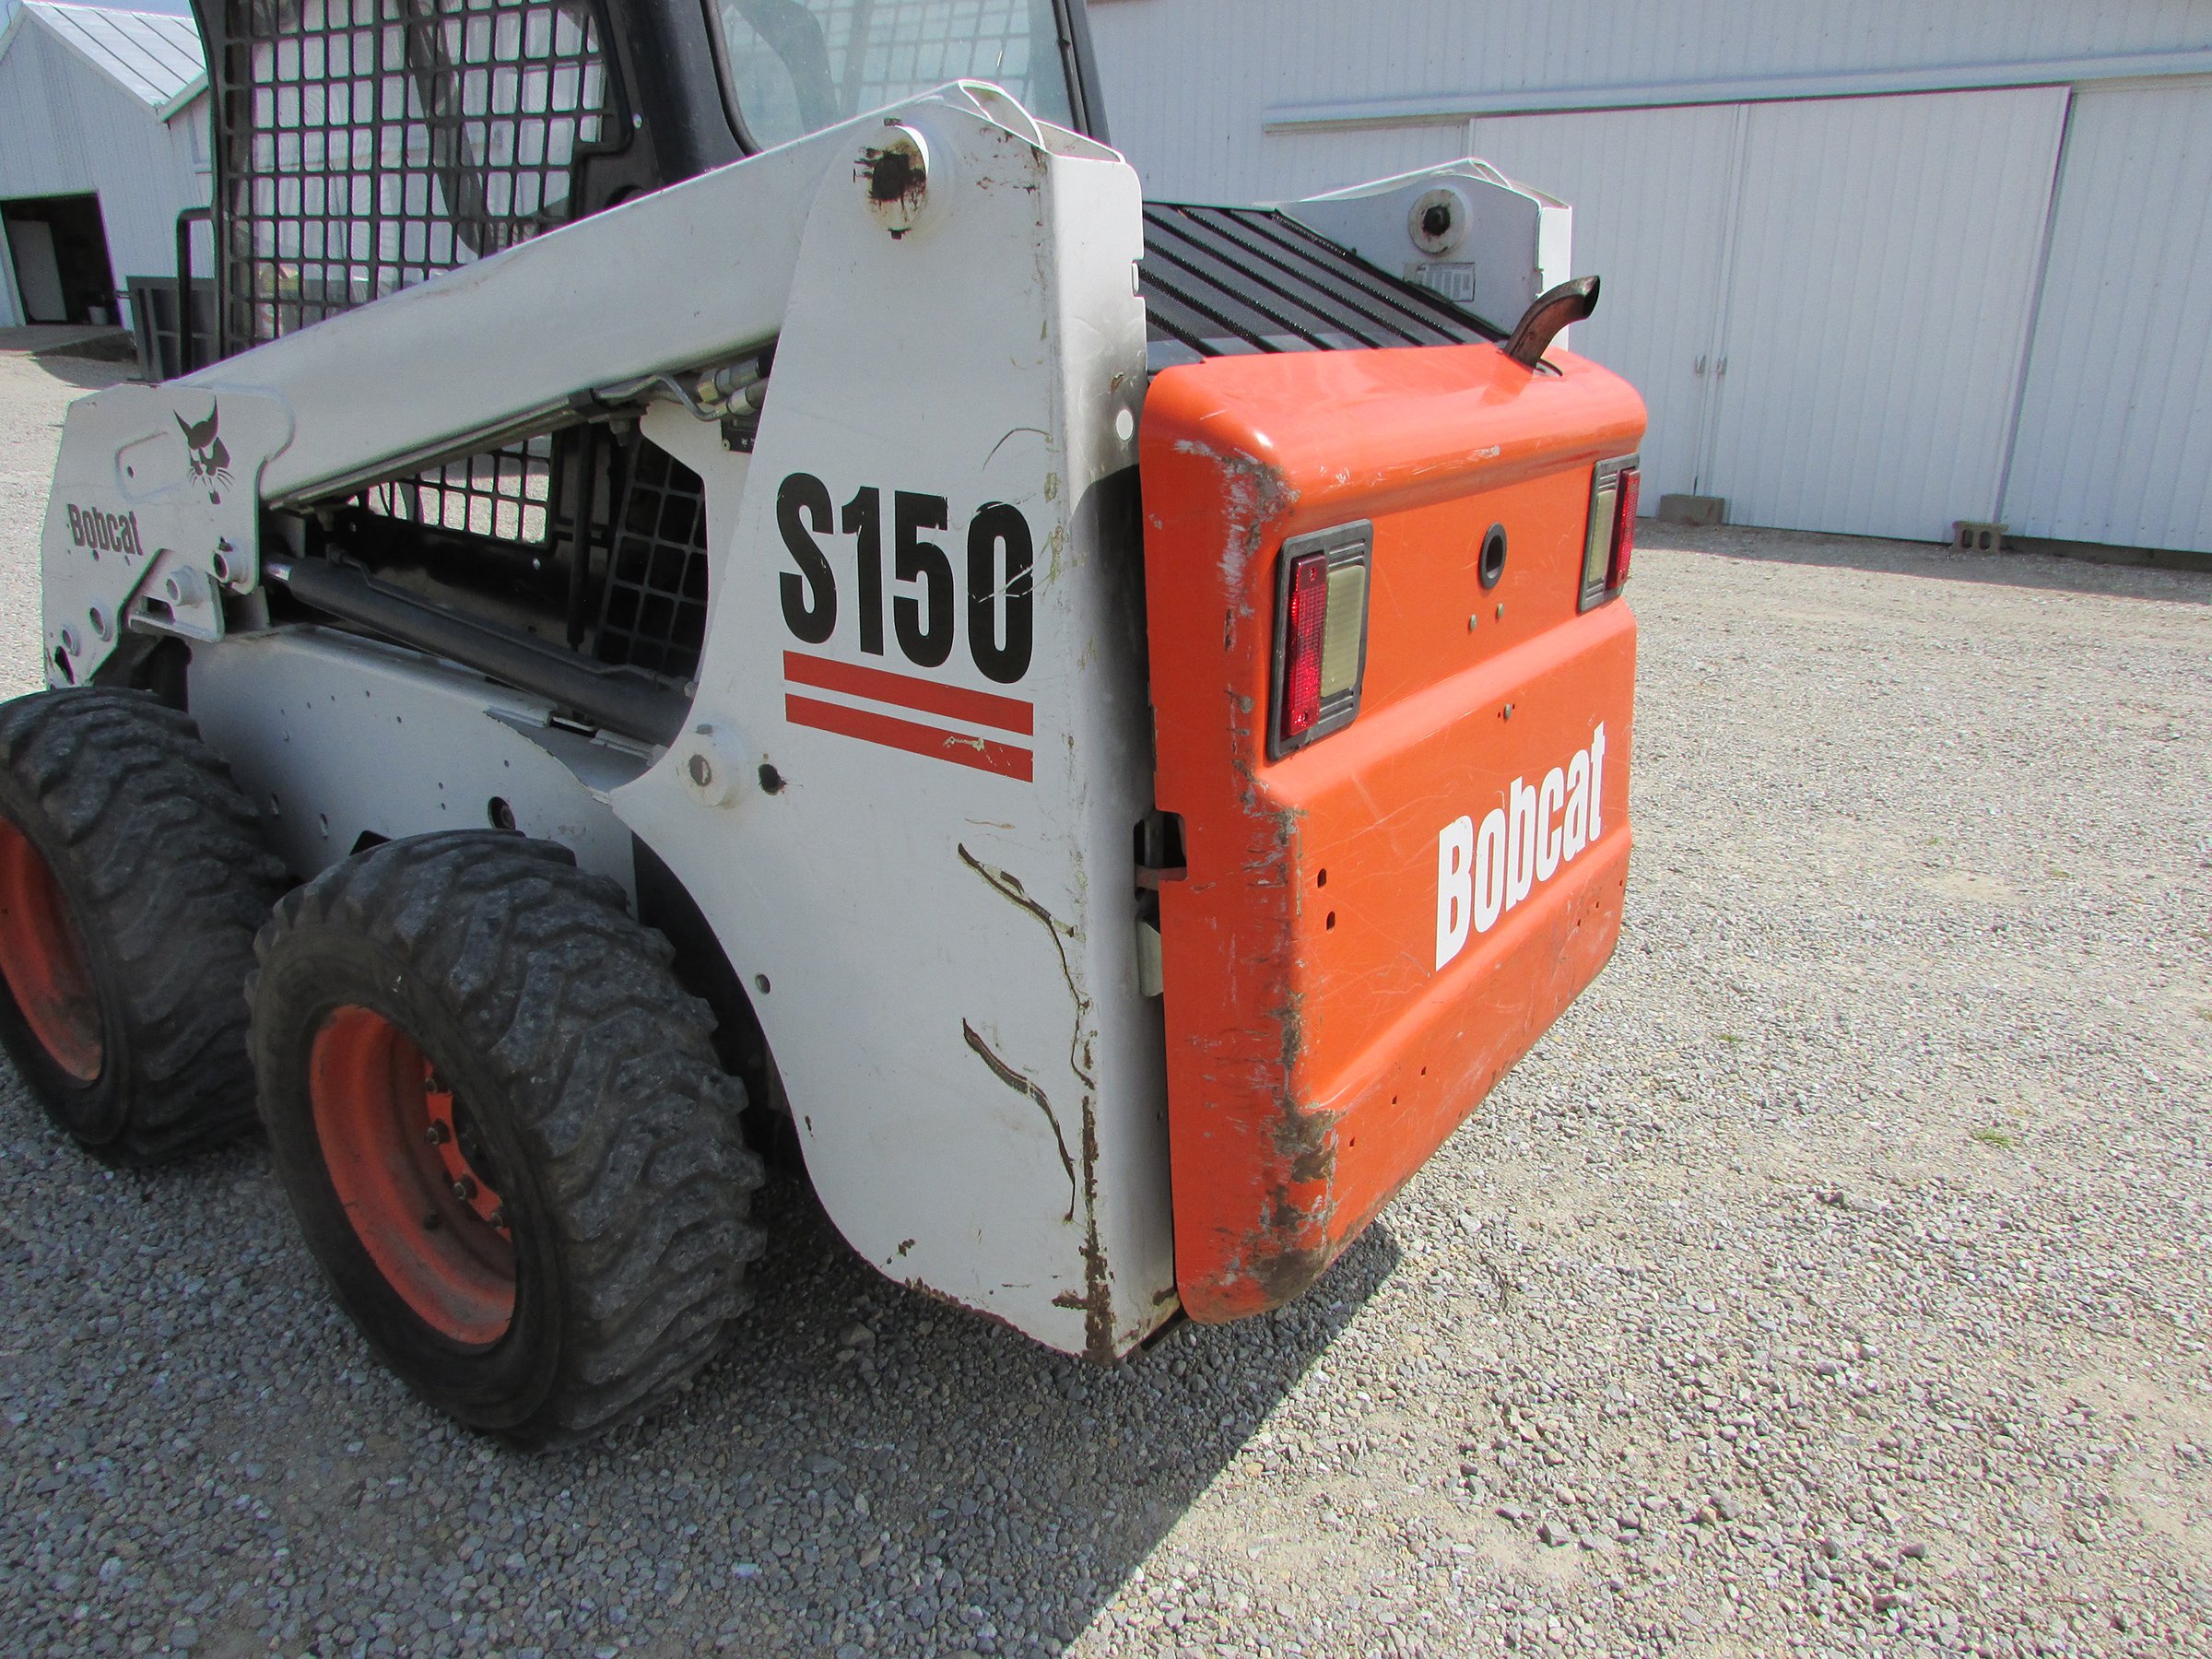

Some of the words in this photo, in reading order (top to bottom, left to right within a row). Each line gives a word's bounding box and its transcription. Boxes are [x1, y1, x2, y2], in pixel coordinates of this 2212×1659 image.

[67, 504, 143, 556] Bobcat
[776, 472, 1033, 684] S150
[1435, 721, 1606, 971] Bobcat
